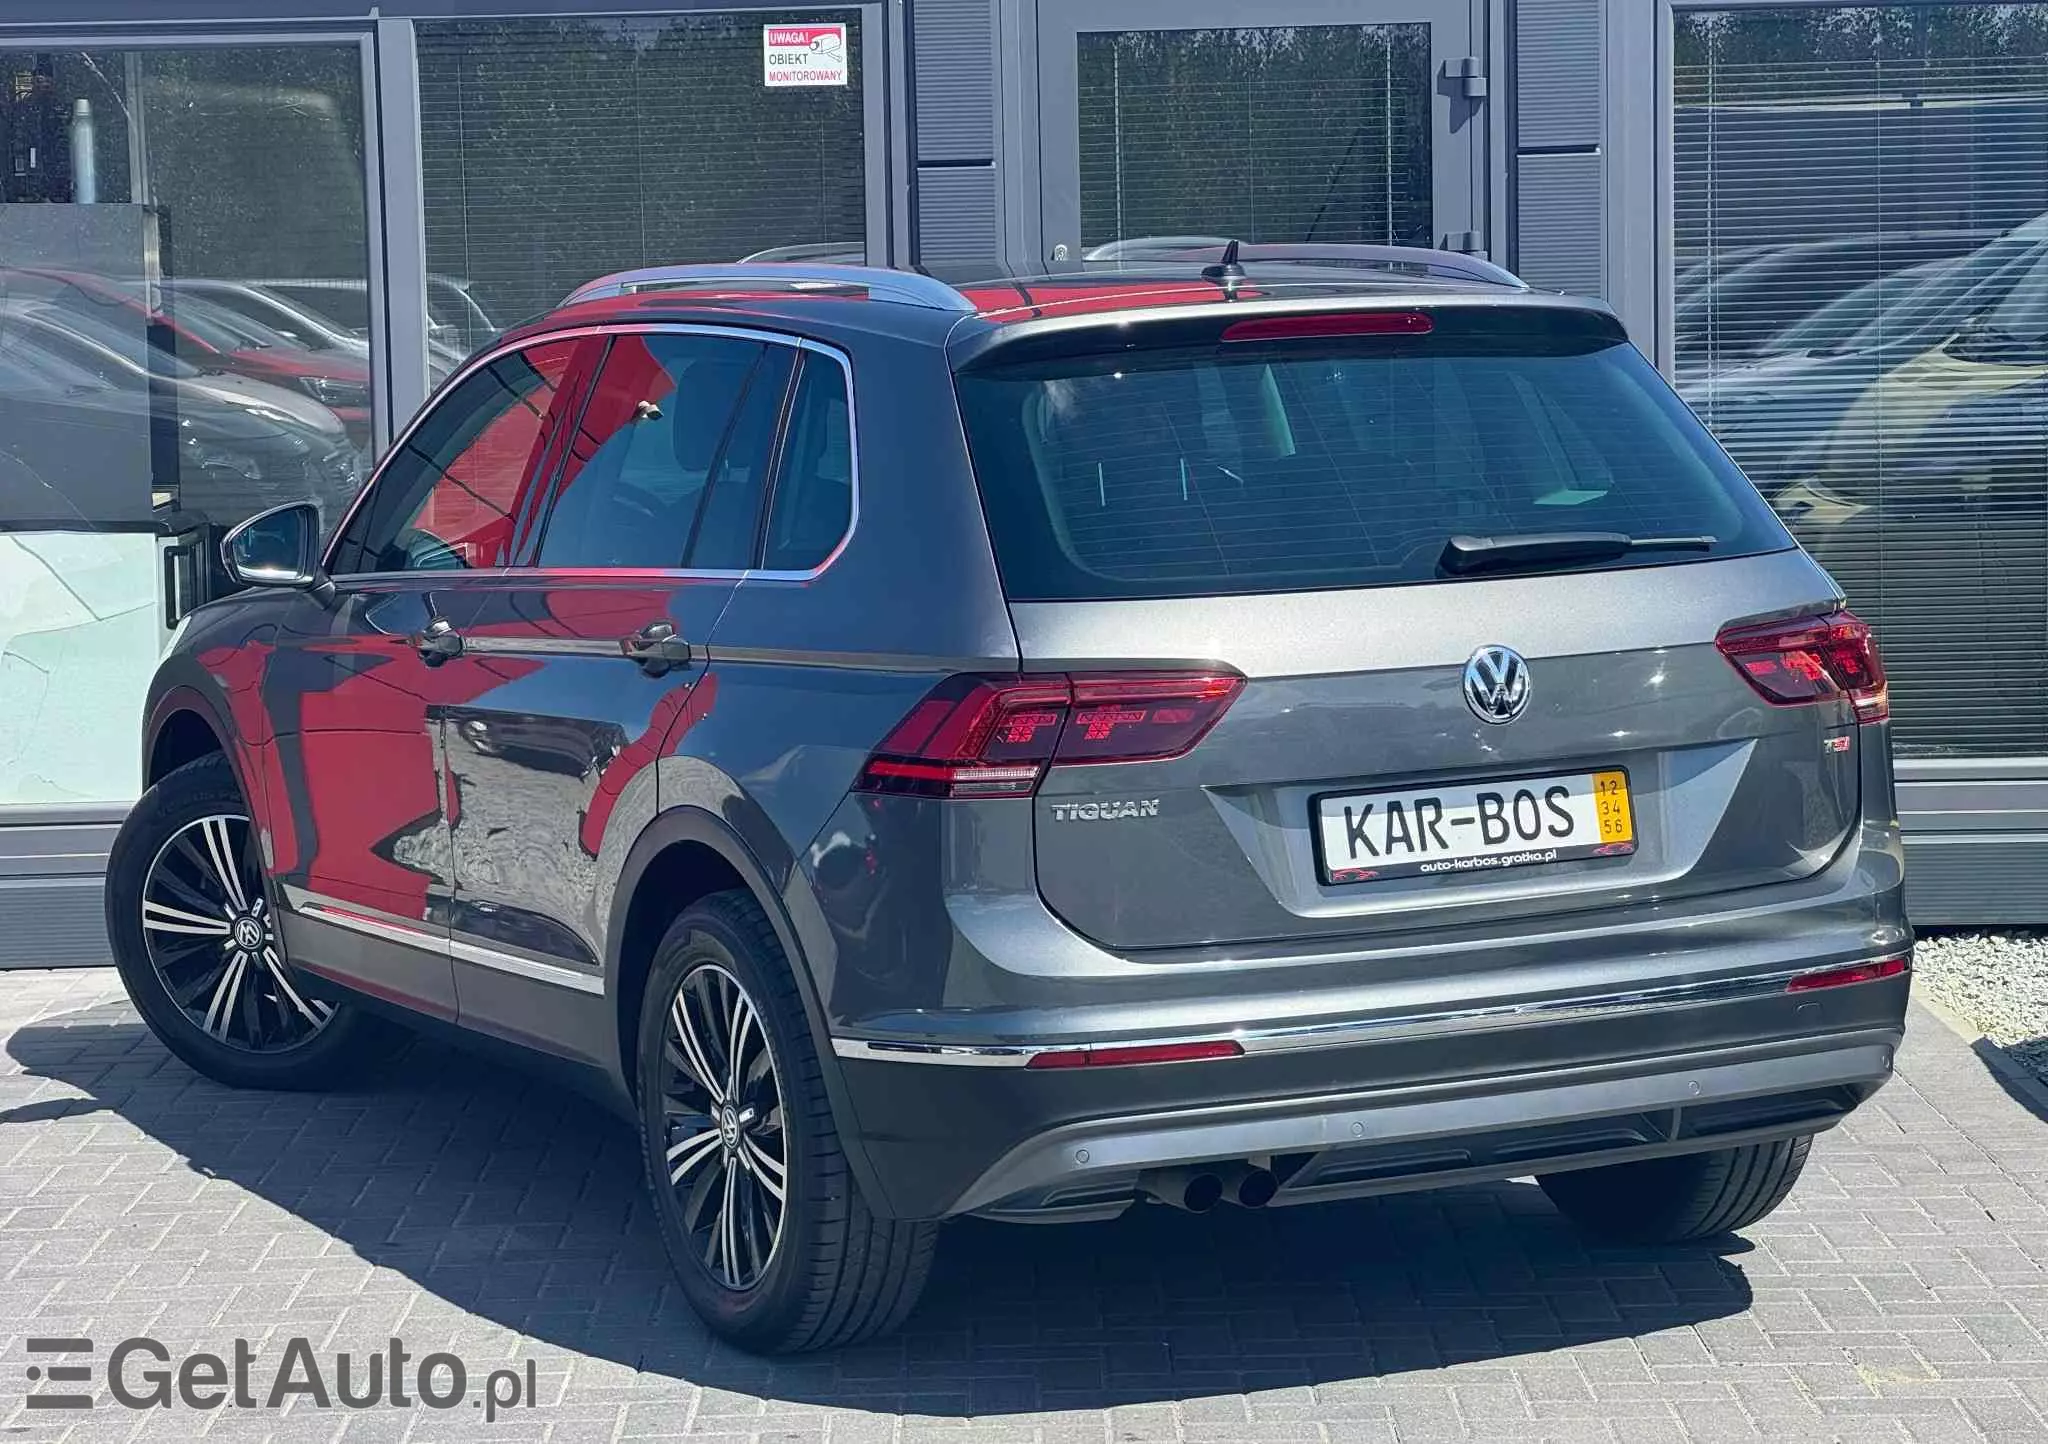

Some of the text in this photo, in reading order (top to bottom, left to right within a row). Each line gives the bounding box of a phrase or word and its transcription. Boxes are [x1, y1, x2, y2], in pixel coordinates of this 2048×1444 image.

[769, 31, 809, 45] UWAGA!
[769, 53, 809, 65] OBIEKT
[769, 70, 842, 82] MONITOROWANY
[1051, 798, 1160, 821] TIGUAN
[1343, 785, 1576, 860] KAR-BOS
[1420, 849, 1557, 872] auto-karbos.gratka.pl
